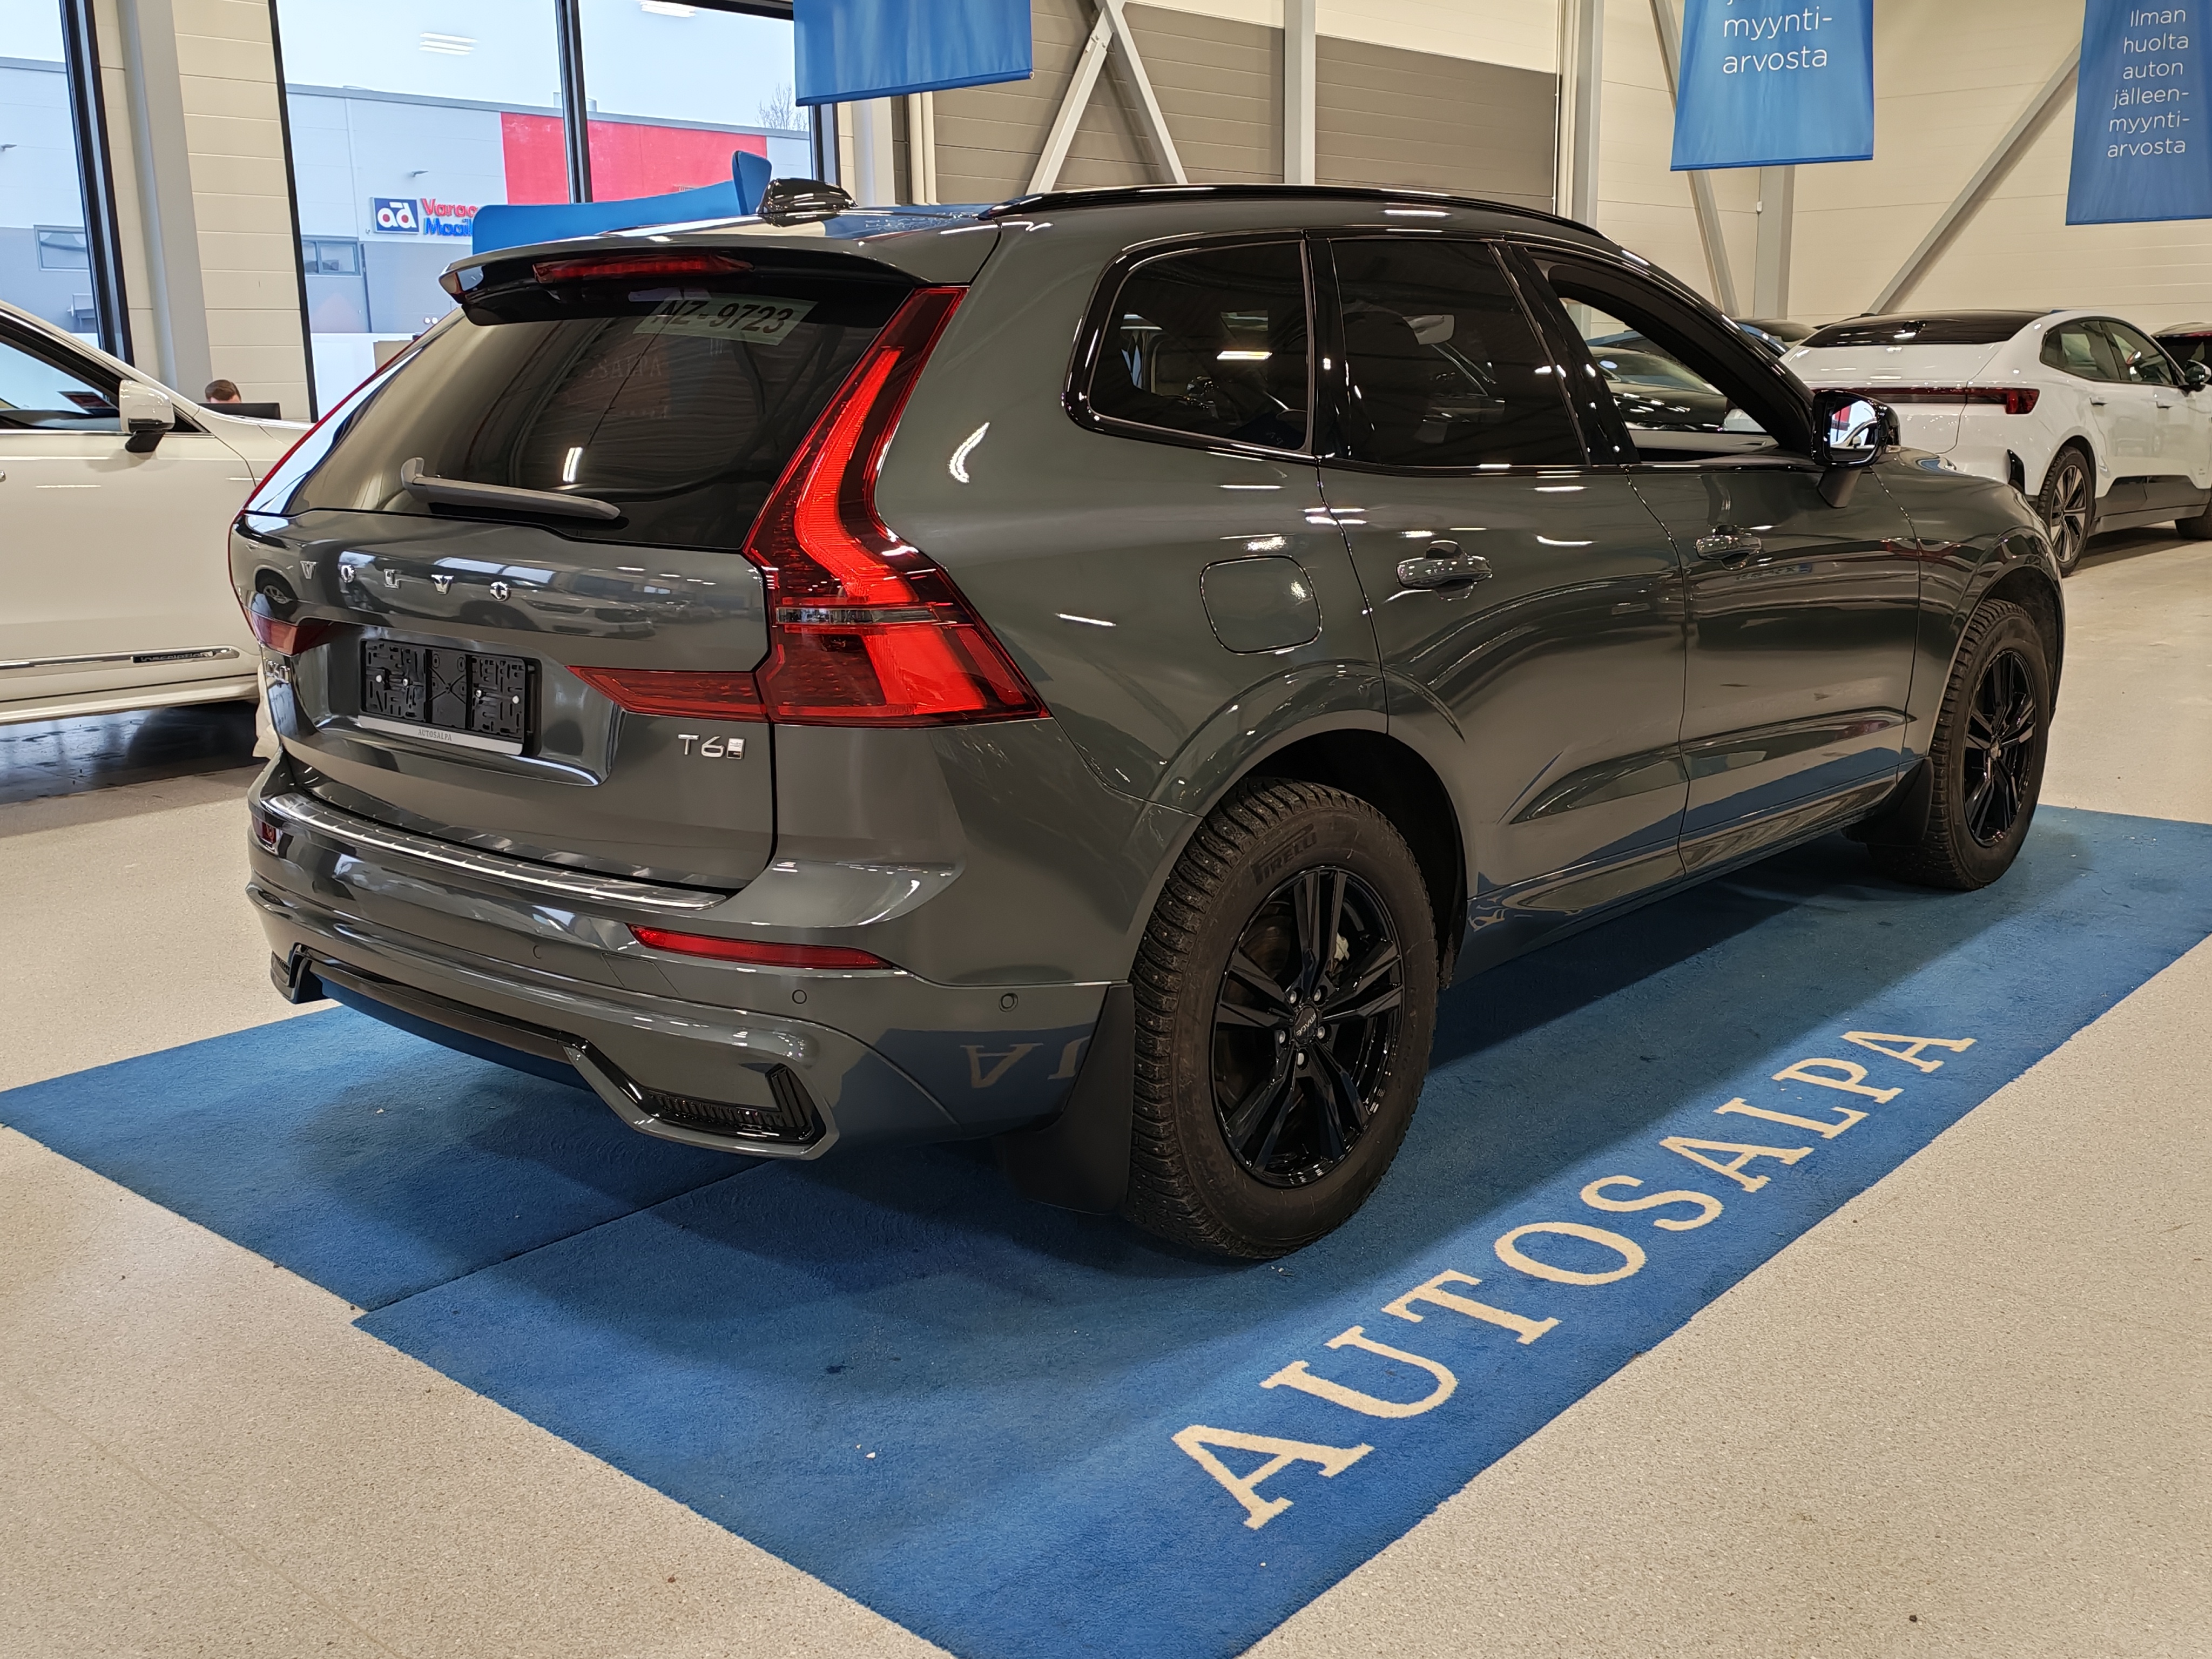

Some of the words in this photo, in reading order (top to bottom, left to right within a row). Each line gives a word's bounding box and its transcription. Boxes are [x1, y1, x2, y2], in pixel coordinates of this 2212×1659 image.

[1723, 6, 1833, 41] myynti-
[2130, 9, 2186, 27] Ilman
[2123, 32, 2189, 54] huolta
[1723, 45, 1828, 74] arvosta
[2122, 61, 2184, 80] auton
[2112, 86, 2190, 110] jälleen-
[2108, 110, 2190, 134] myynti-
[2107, 137, 2186, 158] arvosta
[423, 217, 473, 236] Maail
[651, 300, 794, 334] NZ-9723
[299, 560, 512, 602] VOLVO
[418, 729, 452, 741] AUTOSALPA
[678, 734, 725, 757] T6
[1170, 1029, 1978, 1530] AUTOSALPA
